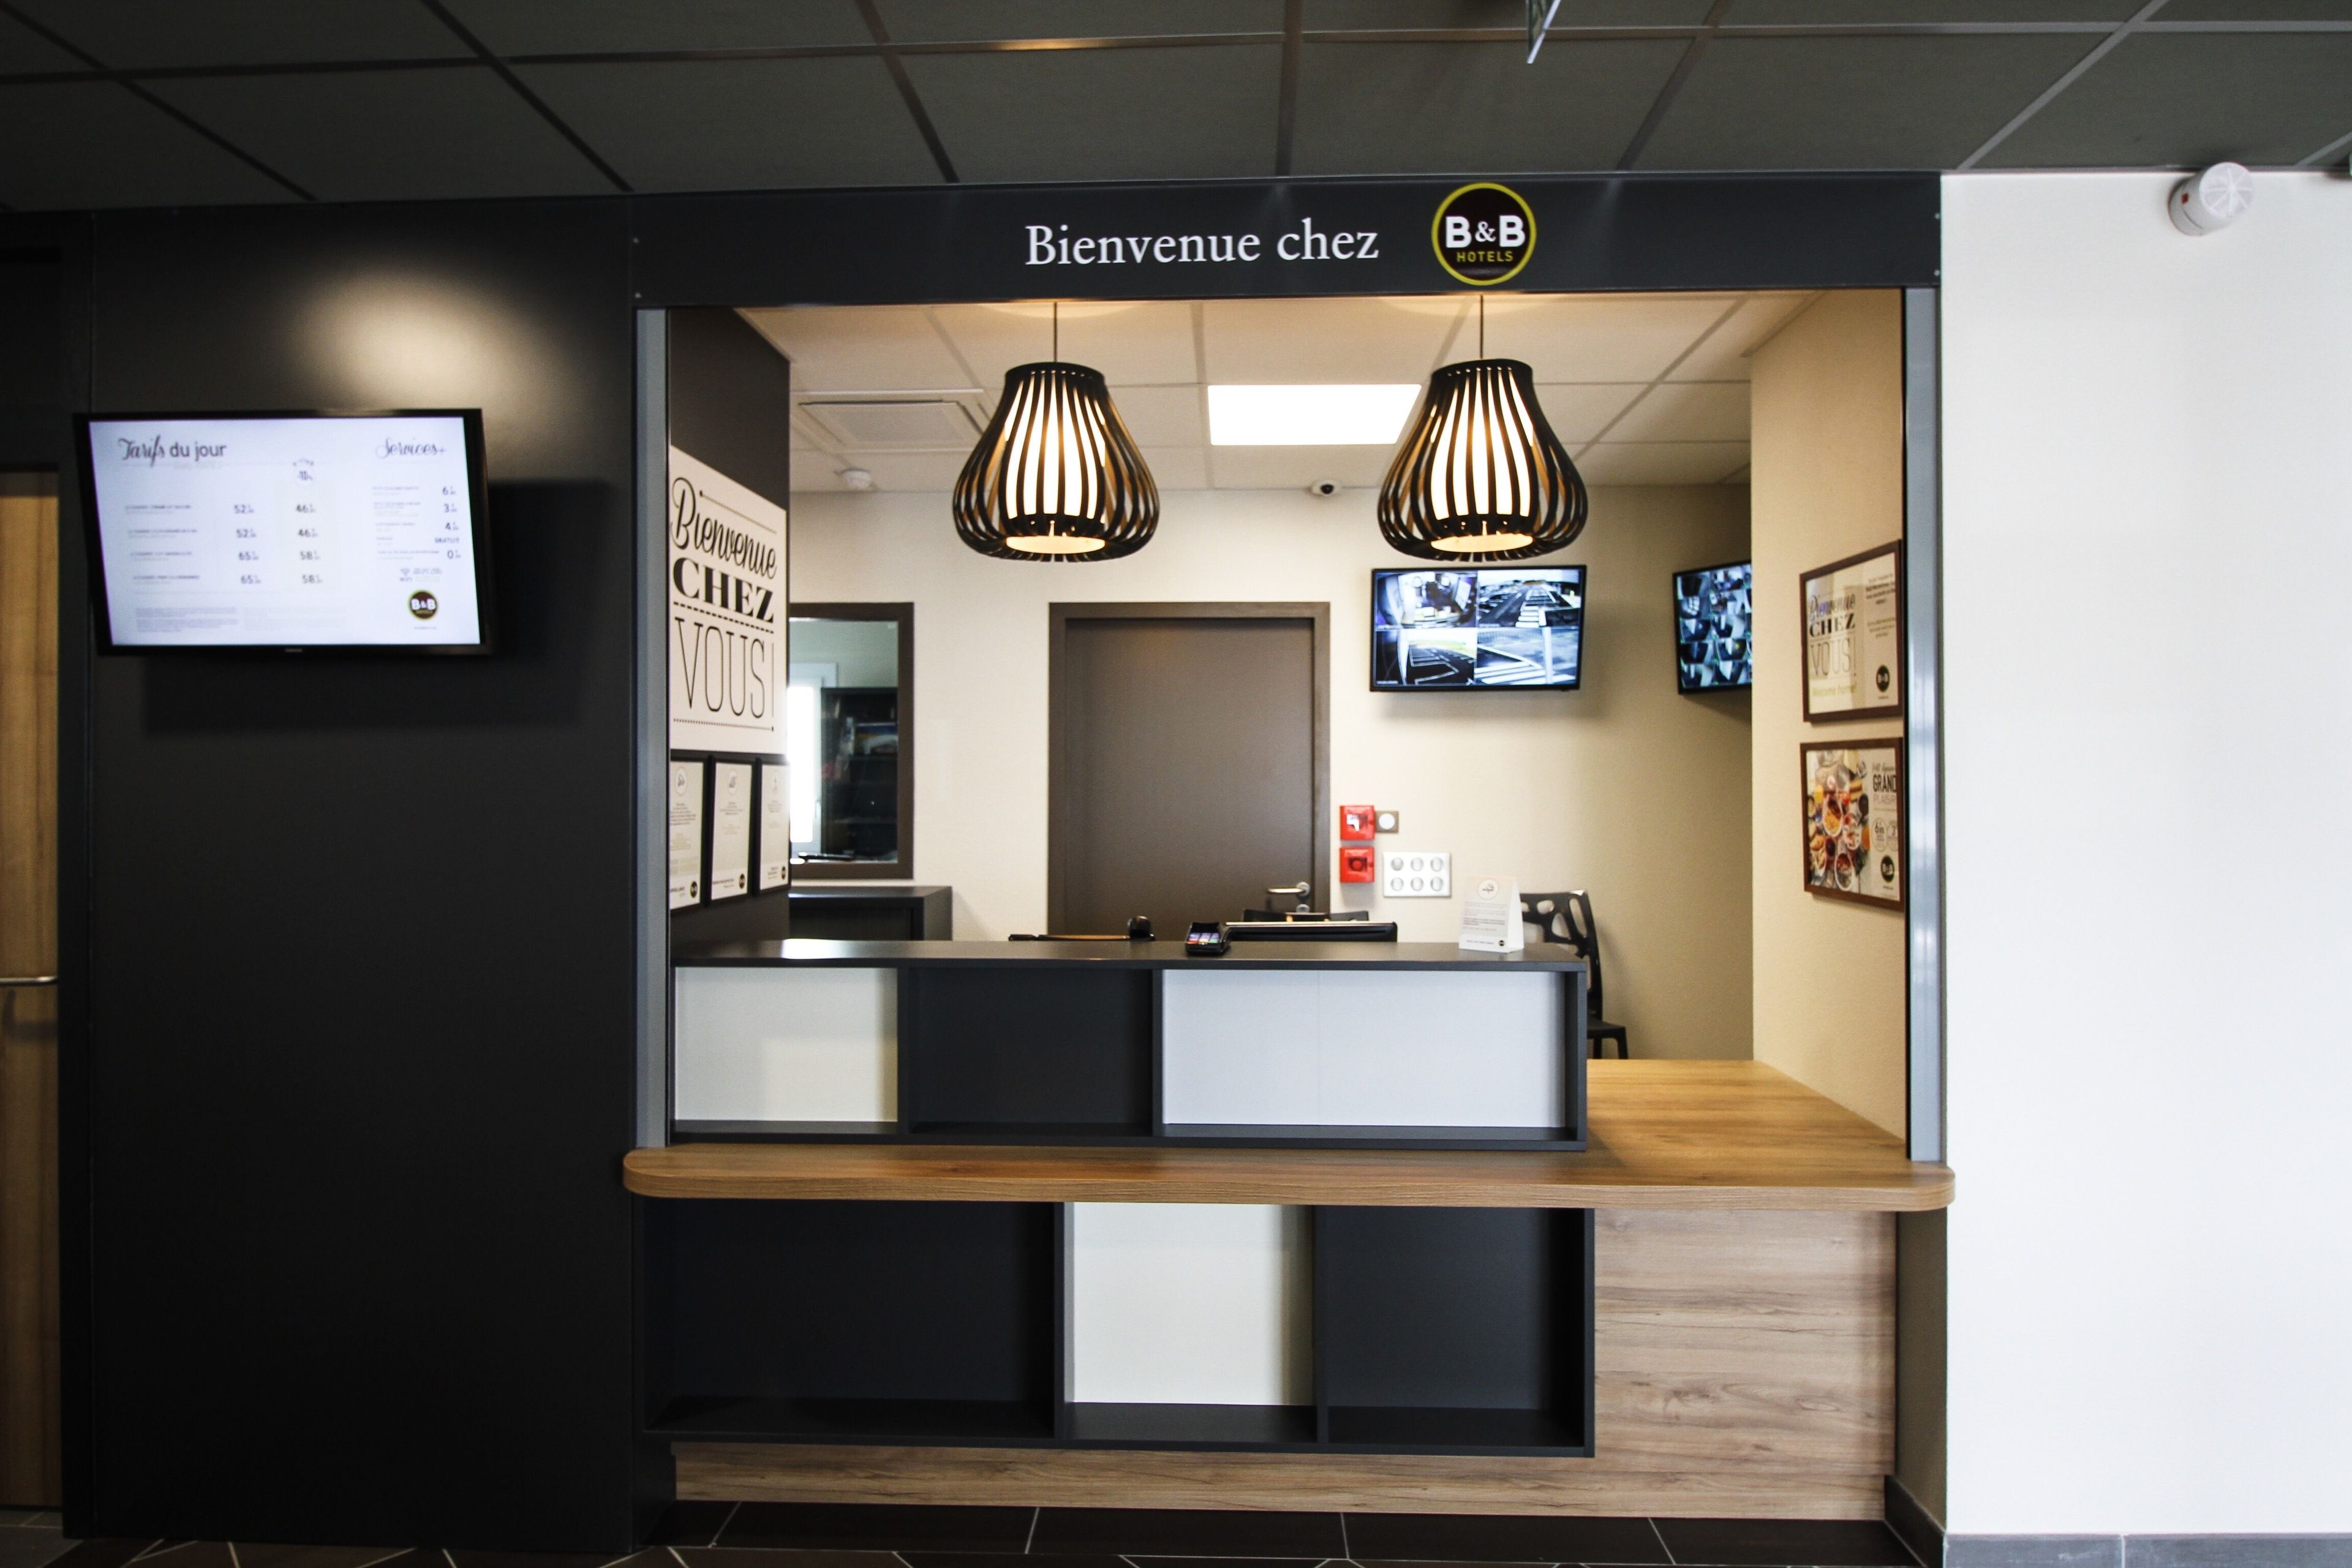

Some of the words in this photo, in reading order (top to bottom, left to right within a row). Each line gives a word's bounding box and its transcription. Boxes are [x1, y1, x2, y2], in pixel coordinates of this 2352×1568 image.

[1025, 224, 1261, 265] Bienvenue
[1276, 217, 1379, 262] chez
[1445, 215, 1526, 249] B&B
[1457, 251, 1513, 263] HOTELS
[118, 434, 165, 468] Tarifs
[170, 442, 190, 458] du
[195, 441, 227, 462] jour
[669, 477, 777, 580] Bienvenue
[410, 598, 436, 611] B&B
[673, 557, 774, 624] CHEZ
[1809, 612, 1856, 638] CHEZ
[1872, 774, 1897, 793] GRAND
